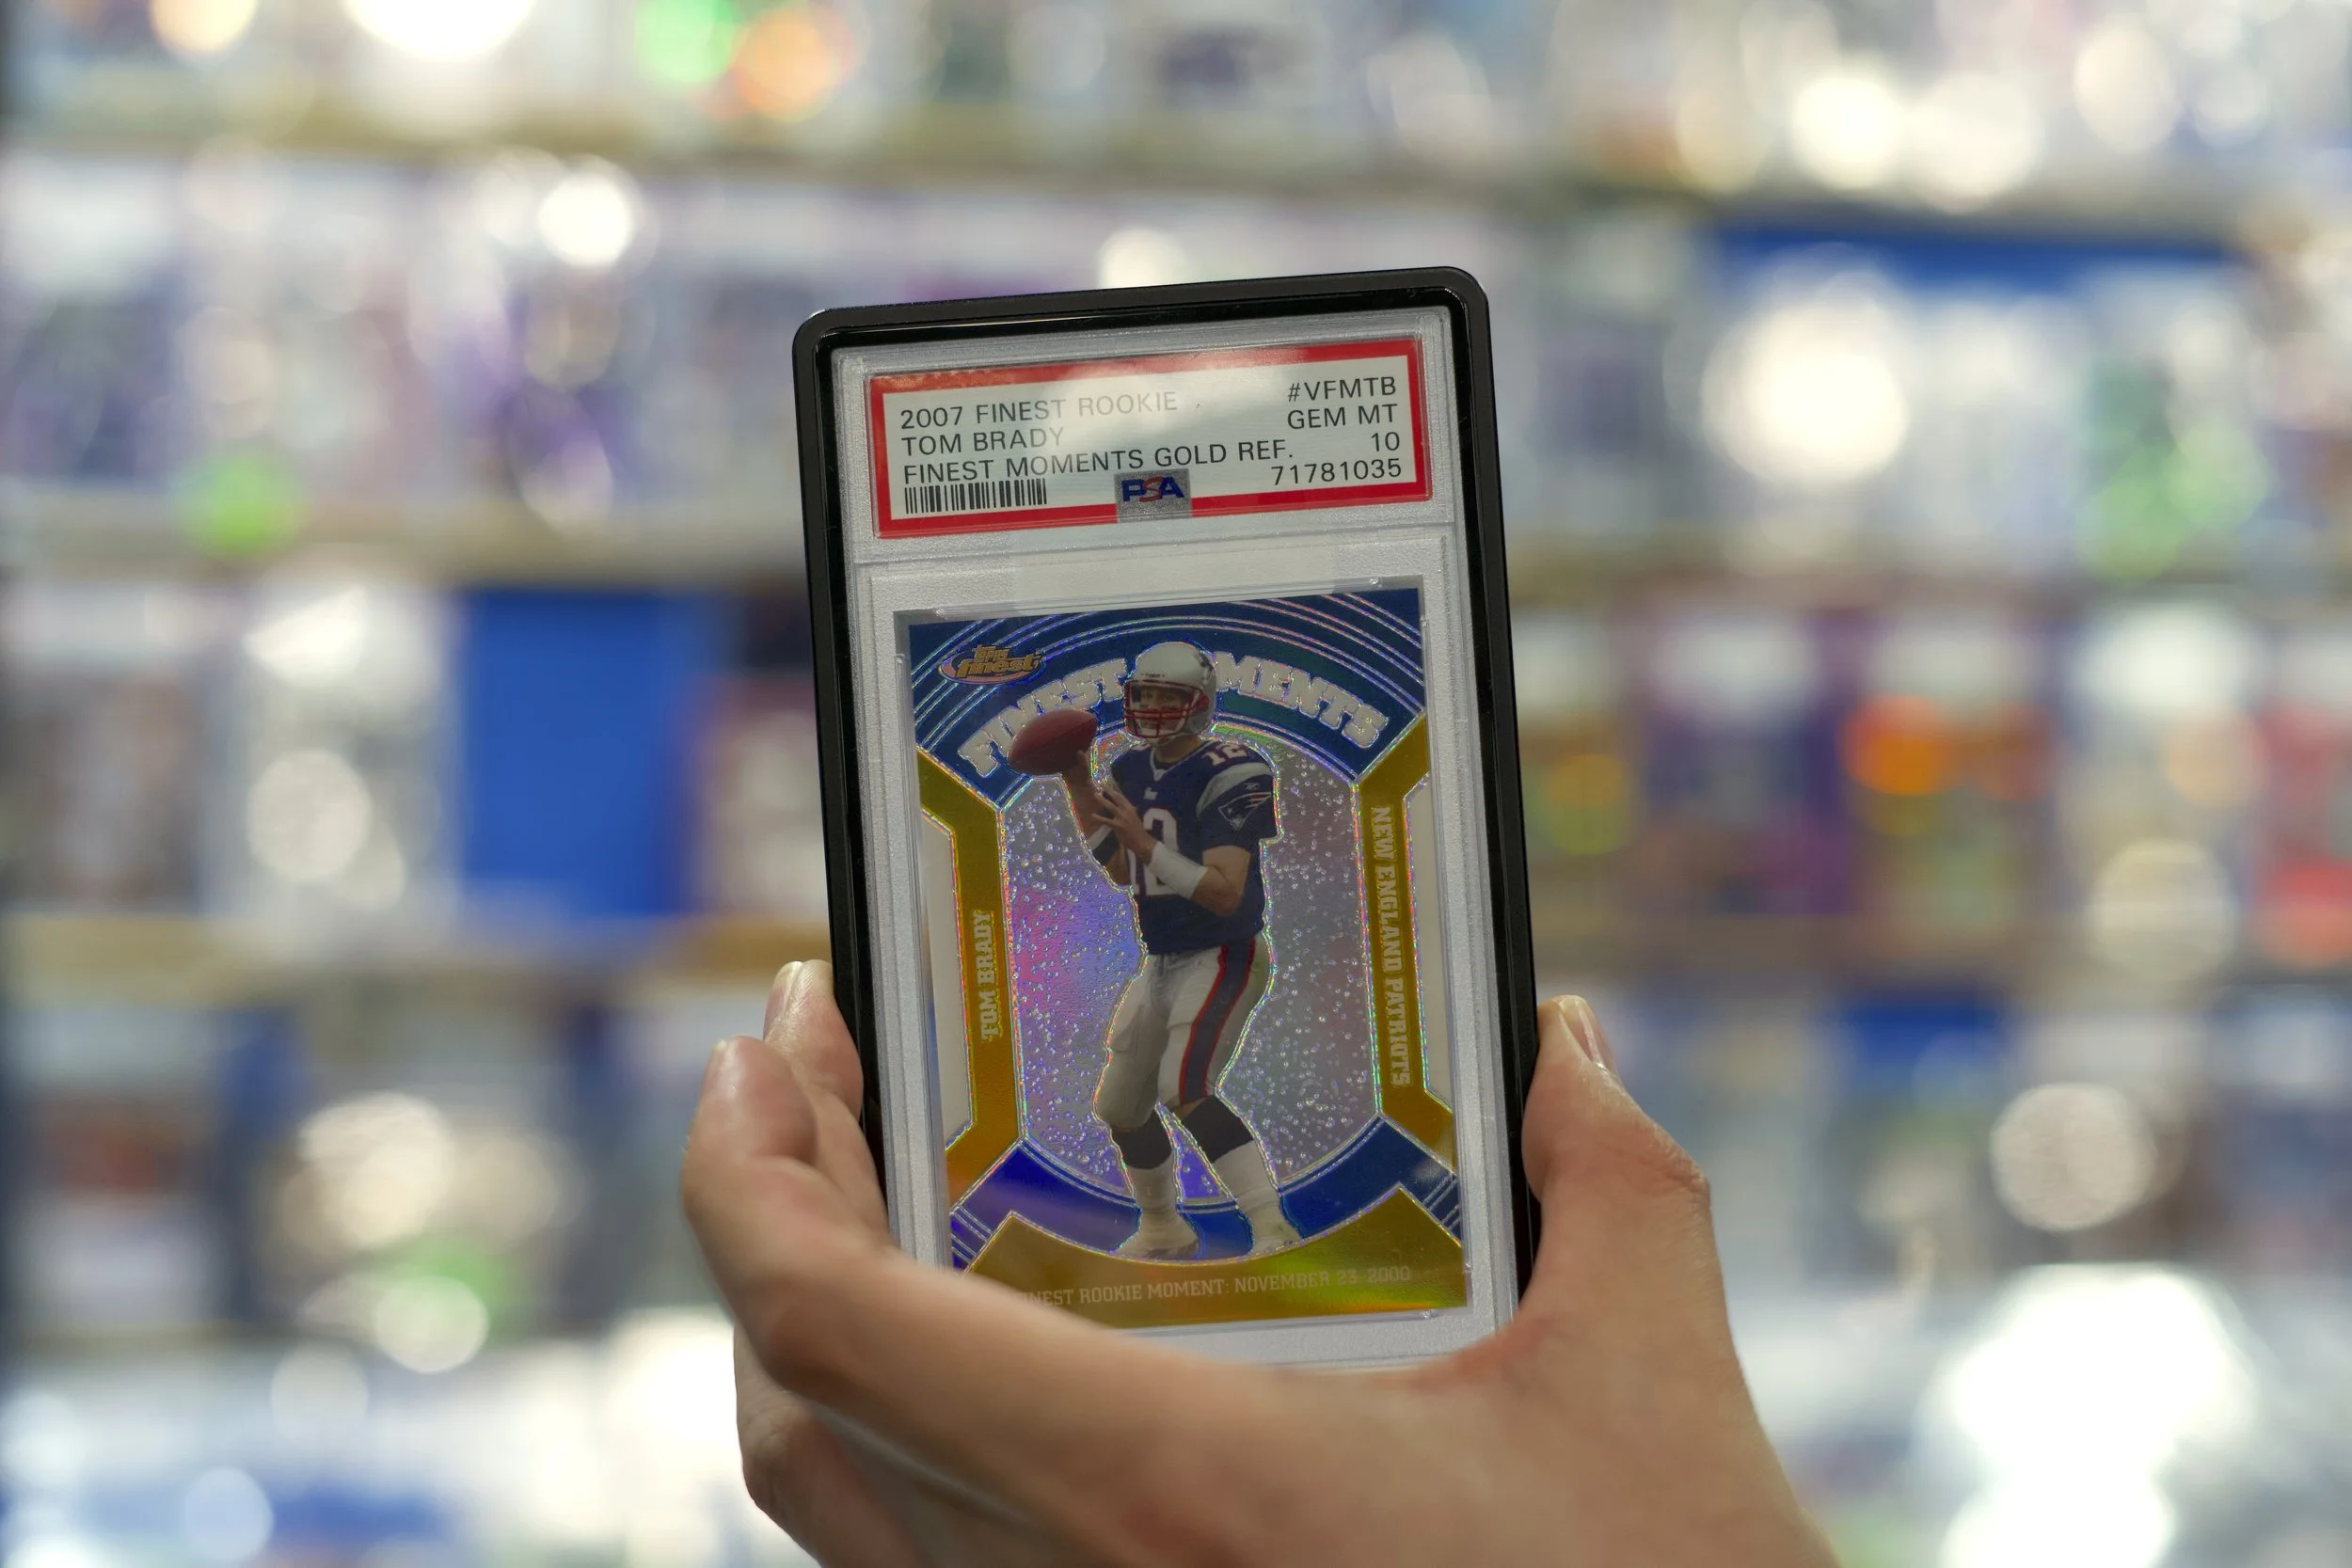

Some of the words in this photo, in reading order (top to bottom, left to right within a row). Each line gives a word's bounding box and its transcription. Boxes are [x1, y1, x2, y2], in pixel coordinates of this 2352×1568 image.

[1287, 376, 1397, 402] #VFMTB
[900, 406, 963, 429] 2007
[976, 399, 1067, 424] FINEST
[1078, 391, 1178, 417] ROOKIE
[1287, 407, 1346, 430] GEM
[1358, 404, 1398, 425] MT
[901, 434, 962, 456] TOM
[973, 427, 1065, 451] BRADY
[903, 460, 994, 484] FINEST
[1006, 450, 1144, 478] MOMENTS
[1153, 444, 1228, 467] GOLD
[1238, 439, 1294, 462] REF.
[1371, 432, 1401, 452] 10
[1120, 476, 1185, 503] PSA
[1270, 458, 1402, 485] 71781035
[1213, 650, 1390, 750] MENTS
[1373, 806, 1394, 860] NEW
[1375, 865, 1402, 972] ENGLAND
[973, 910, 995, 984] BRADY
[977, 990, 999, 1039] TOM
[1385, 977, 1411, 1086] PATRIOTS
[1019, 1289, 1073, 1306] INEST
[1078, 1284, 1143, 1305] ROOKIE
[1234, 1270, 1330, 1293] NOVEMBER
[1367, 1265, 1411, 1283] 2000
